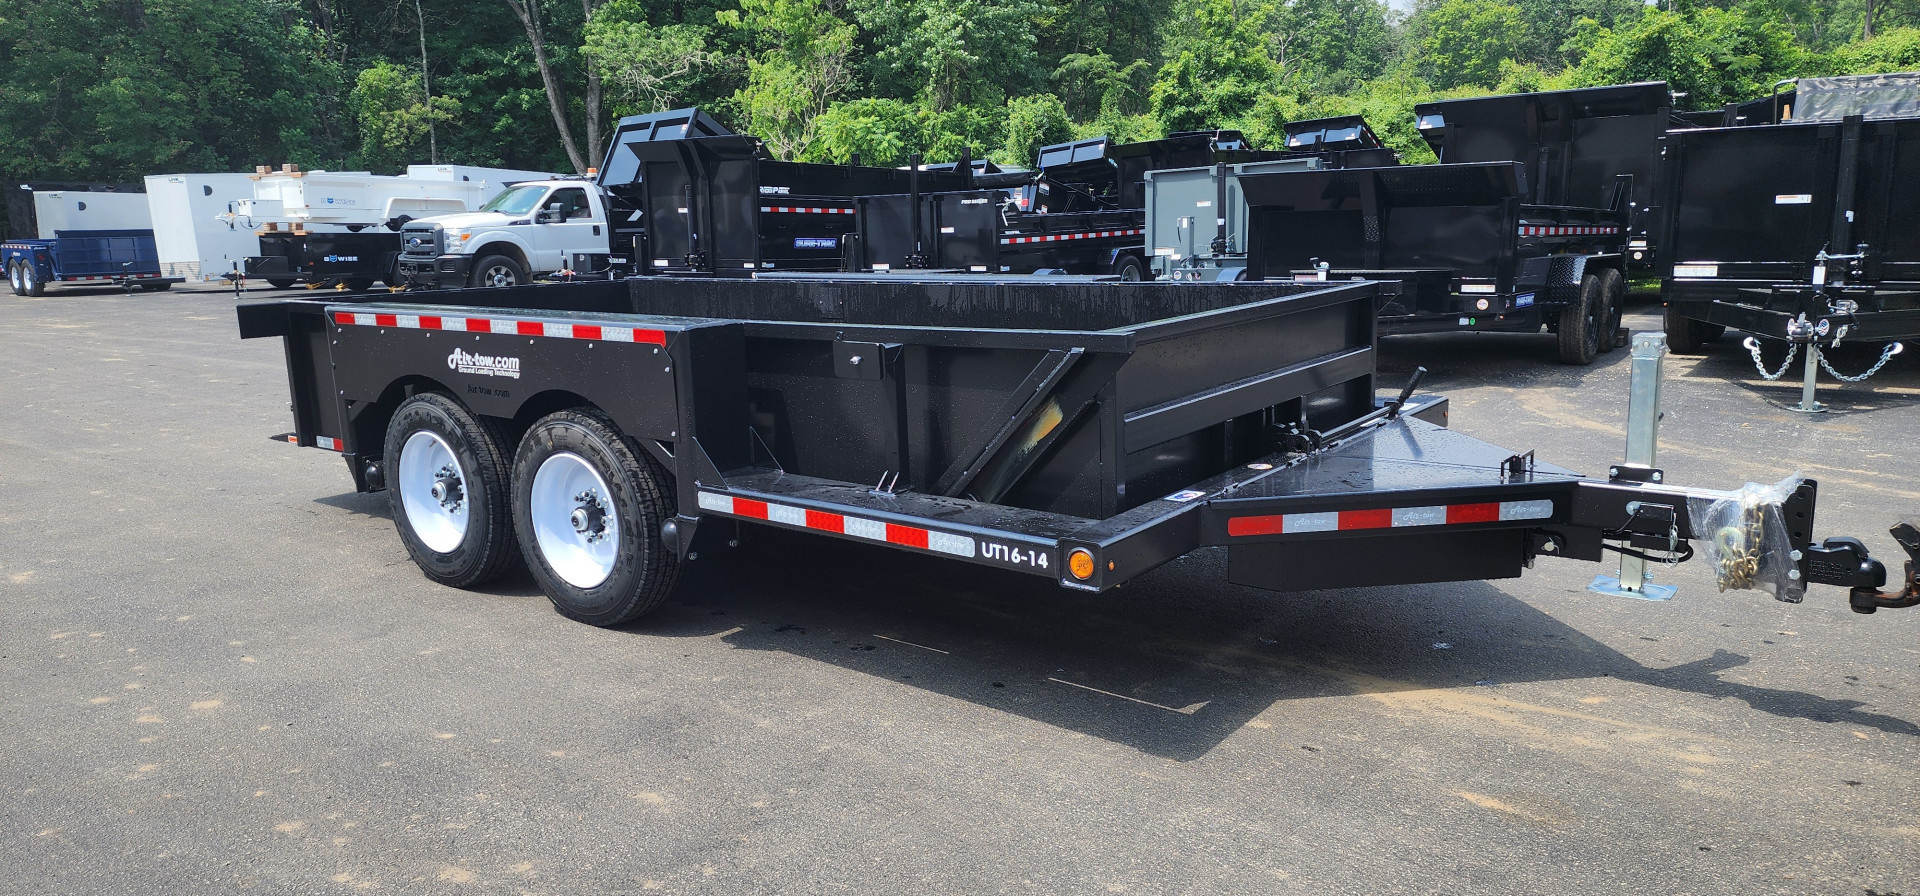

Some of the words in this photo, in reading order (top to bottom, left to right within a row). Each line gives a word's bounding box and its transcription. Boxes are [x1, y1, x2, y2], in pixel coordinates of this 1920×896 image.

[795, 239, 836, 248] SURE-TRAC
[448, 348, 520, 370] Air-tow.com
[458, 366, 475, 374] Ground
[475, 368, 494, 377] Loading
[494, 369, 520, 379] Technology
[1402, 510, 1435, 521] Air-tow
[1509, 505, 1542, 515] Air-tow
[1294, 517, 1327, 527] Air-tow
[981, 541, 1049, 569] UT16-14
